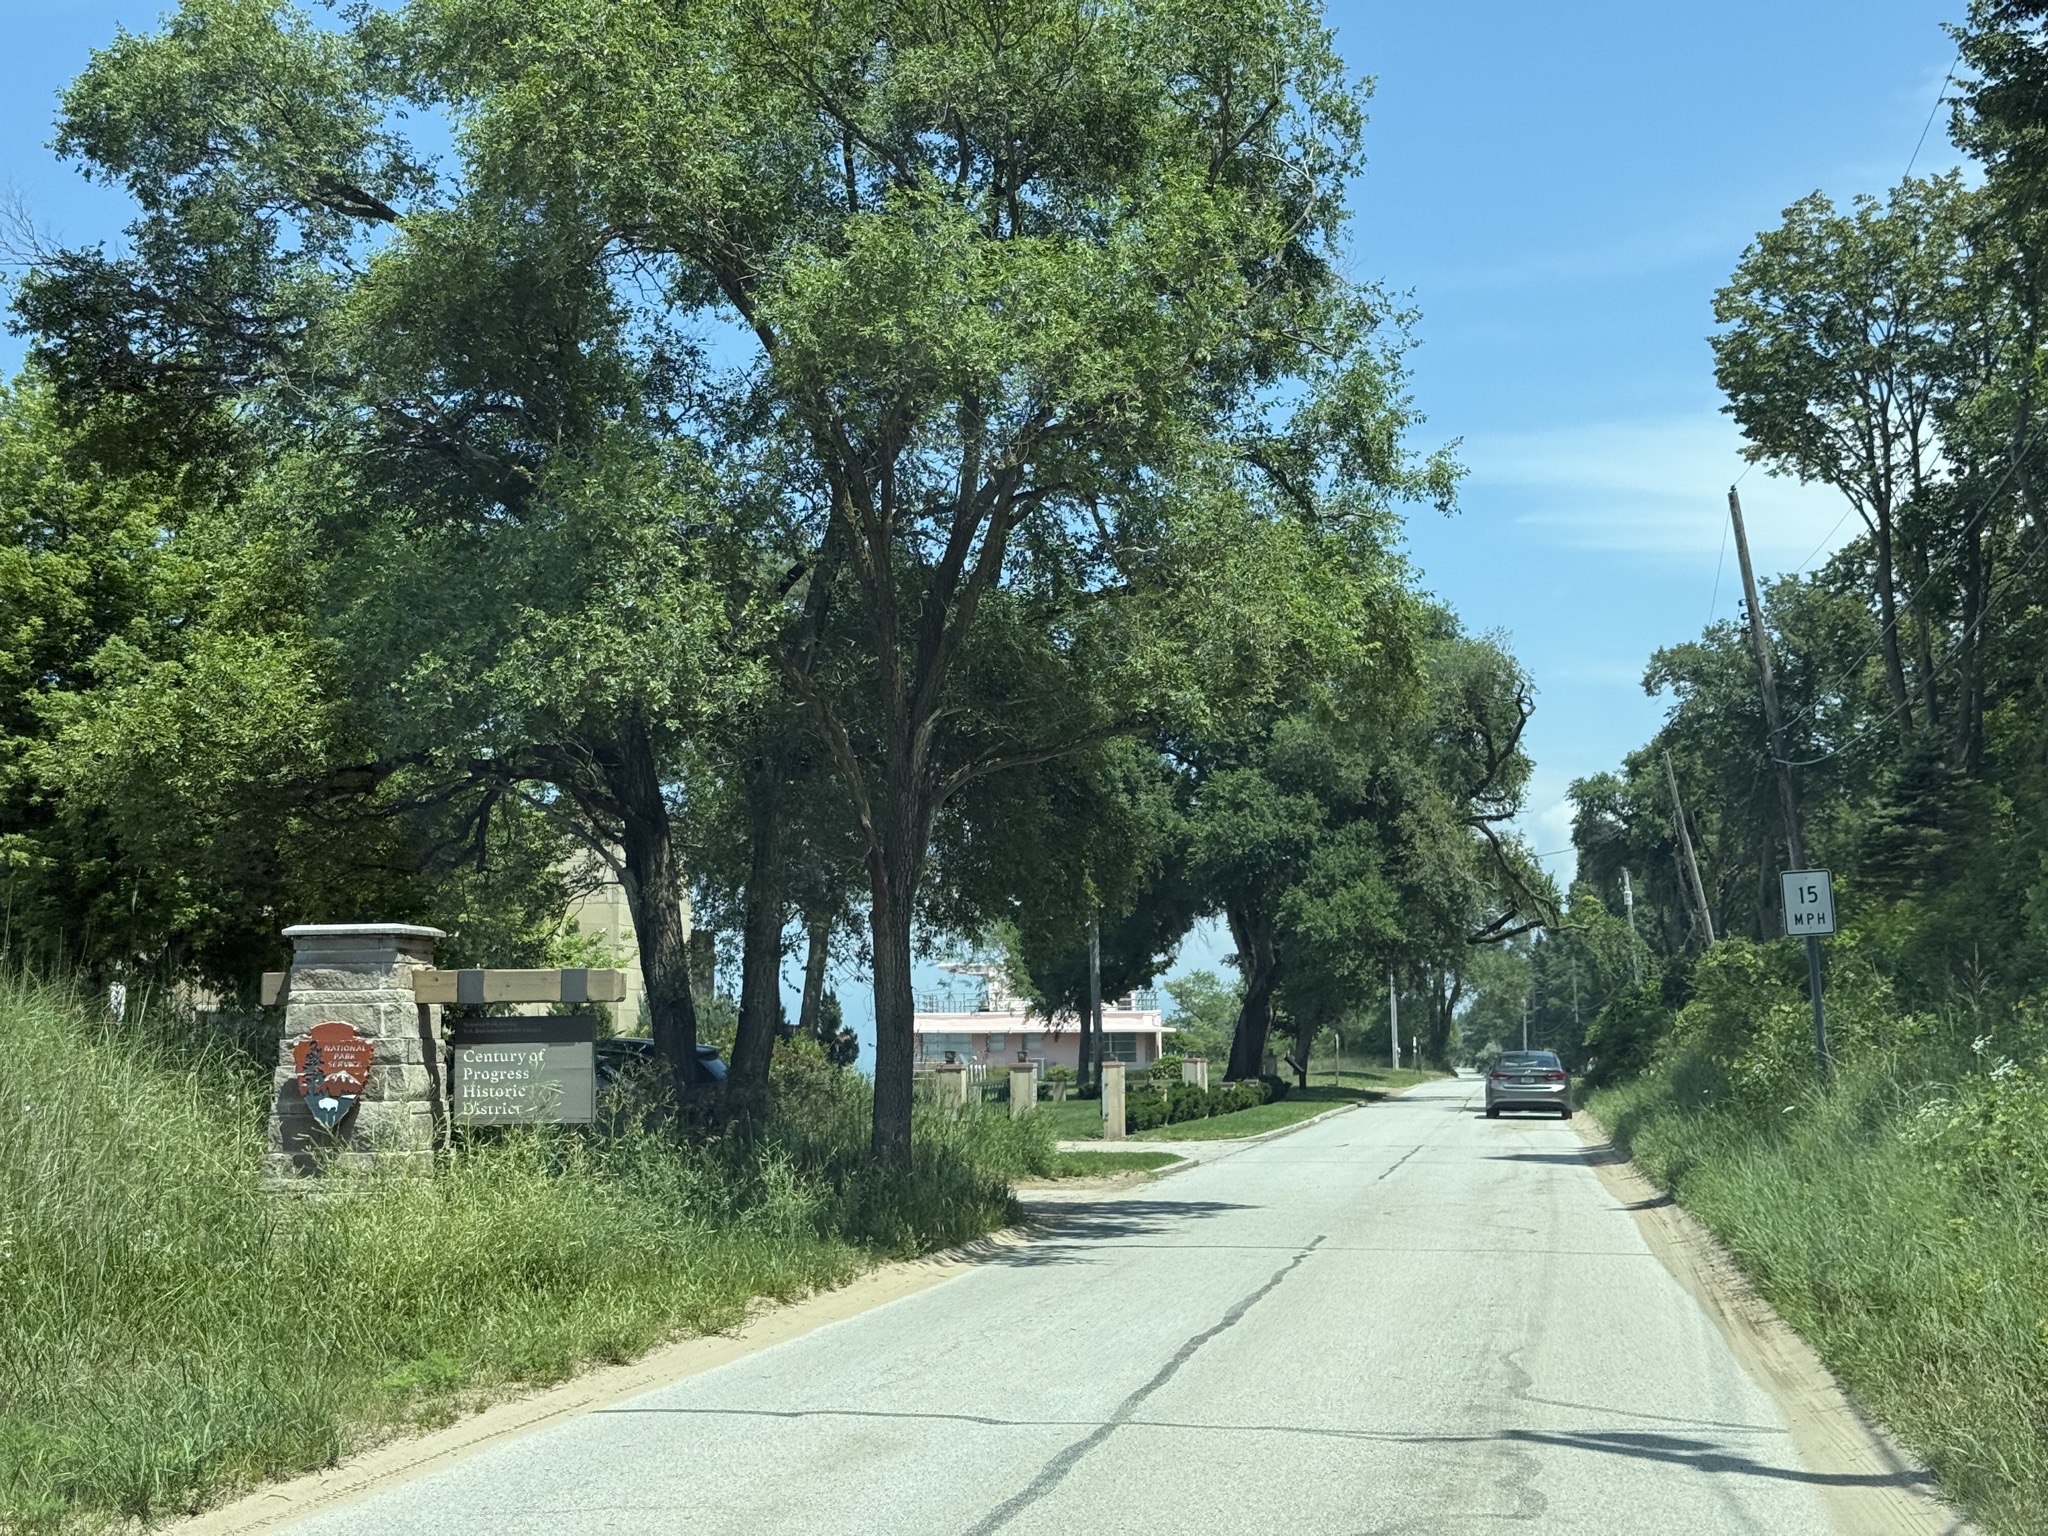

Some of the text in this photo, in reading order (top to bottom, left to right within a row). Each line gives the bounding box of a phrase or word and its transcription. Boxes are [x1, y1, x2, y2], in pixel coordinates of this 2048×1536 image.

[1798, 886, 1818, 904] 15
[1794, 912, 1826, 925] MPH
[323, 1044, 367, 1052] NATIONAL
[463, 1048, 546, 1065] Century of
[463, 1067, 530, 1083] Progress
[462, 1084, 526, 1098] Historic
[462, 1101, 522, 1115] District
